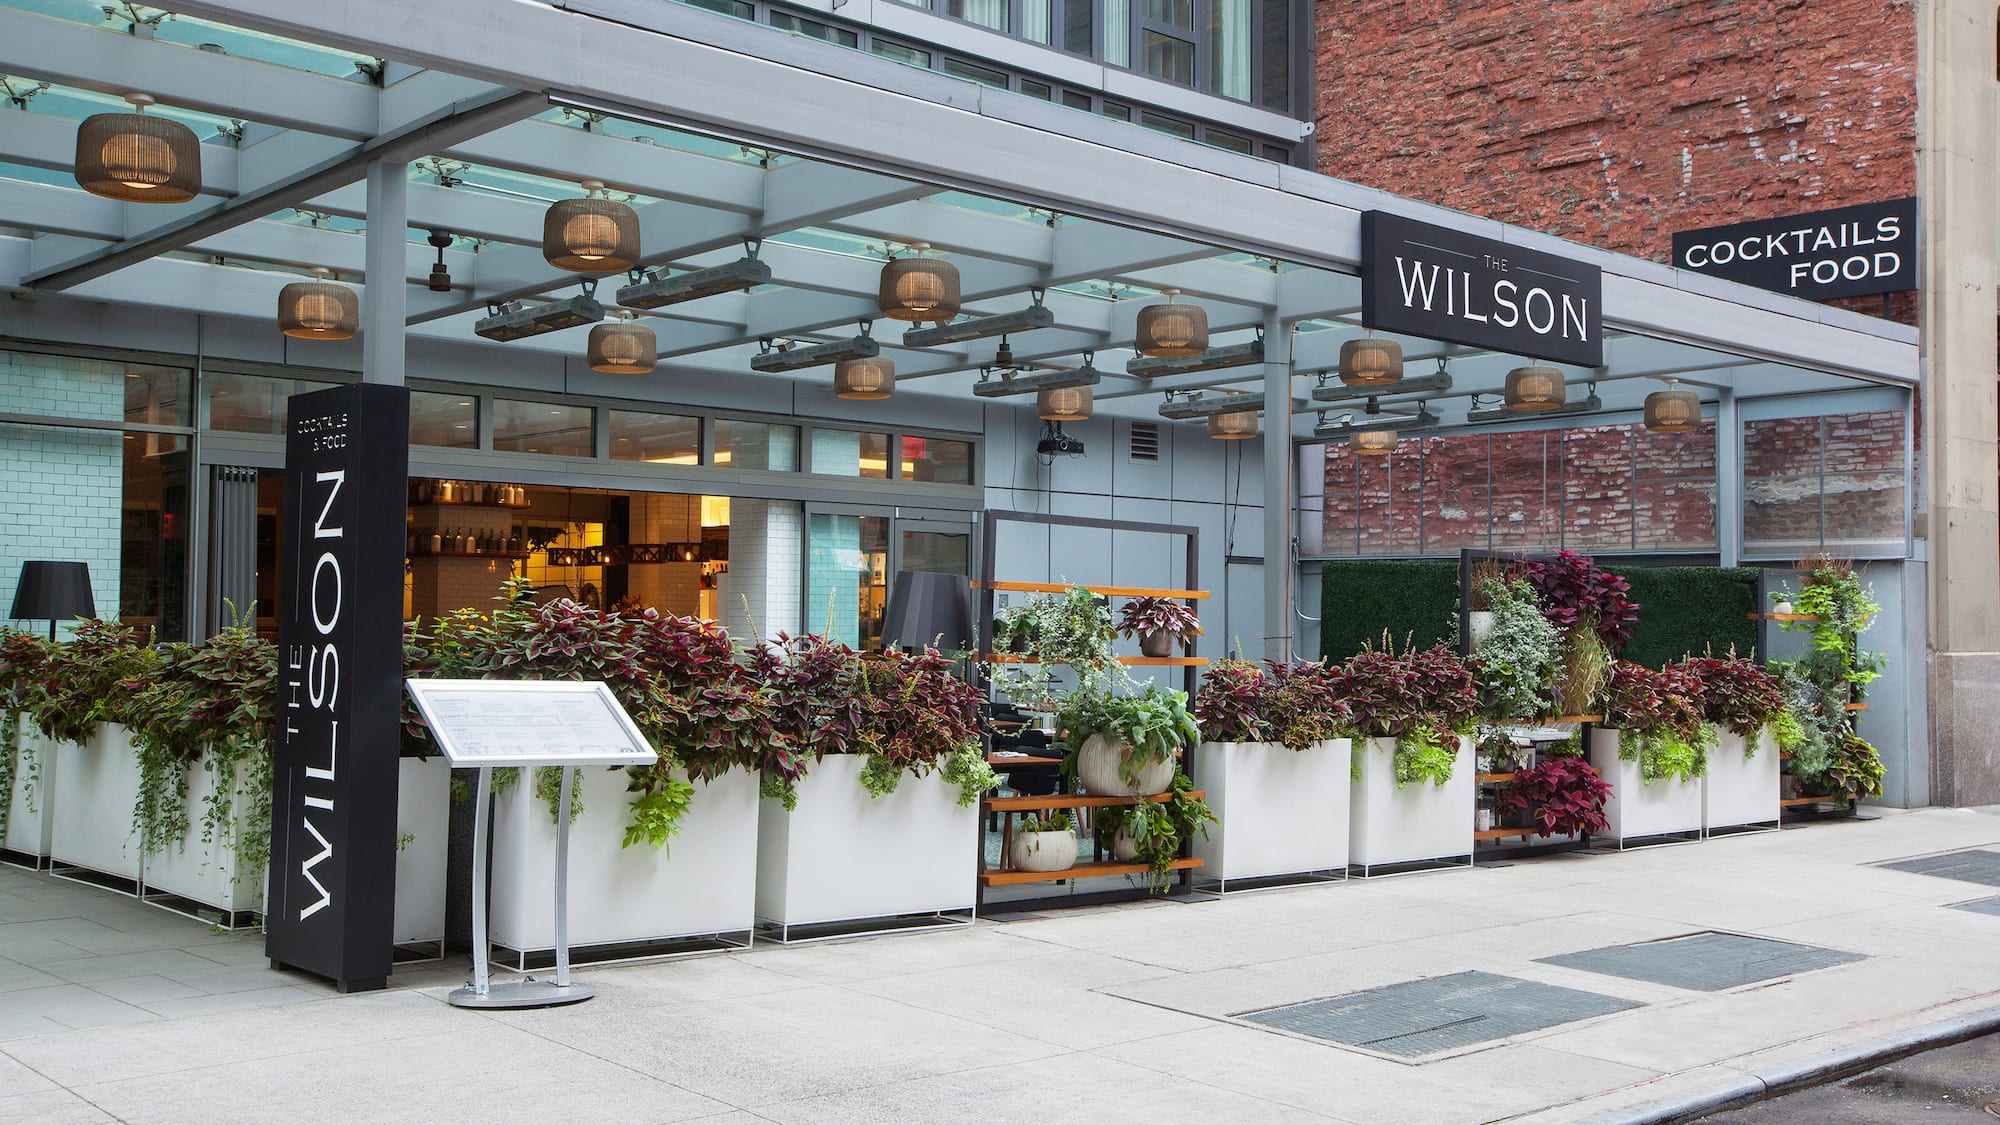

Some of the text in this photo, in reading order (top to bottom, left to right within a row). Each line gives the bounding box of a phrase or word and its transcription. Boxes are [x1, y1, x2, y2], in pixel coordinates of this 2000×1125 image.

[1484, 254, 1509, 273] THE
[1685, 217, 1901, 268] COCKTAILS
[1790, 252, 1901, 288] FOOD
[1395, 256, 1588, 342] WILSON
[298, 413, 348, 434] COCKTALS
[285, 643, 303, 744] THE
[300, 469, 345, 921] WILSON
